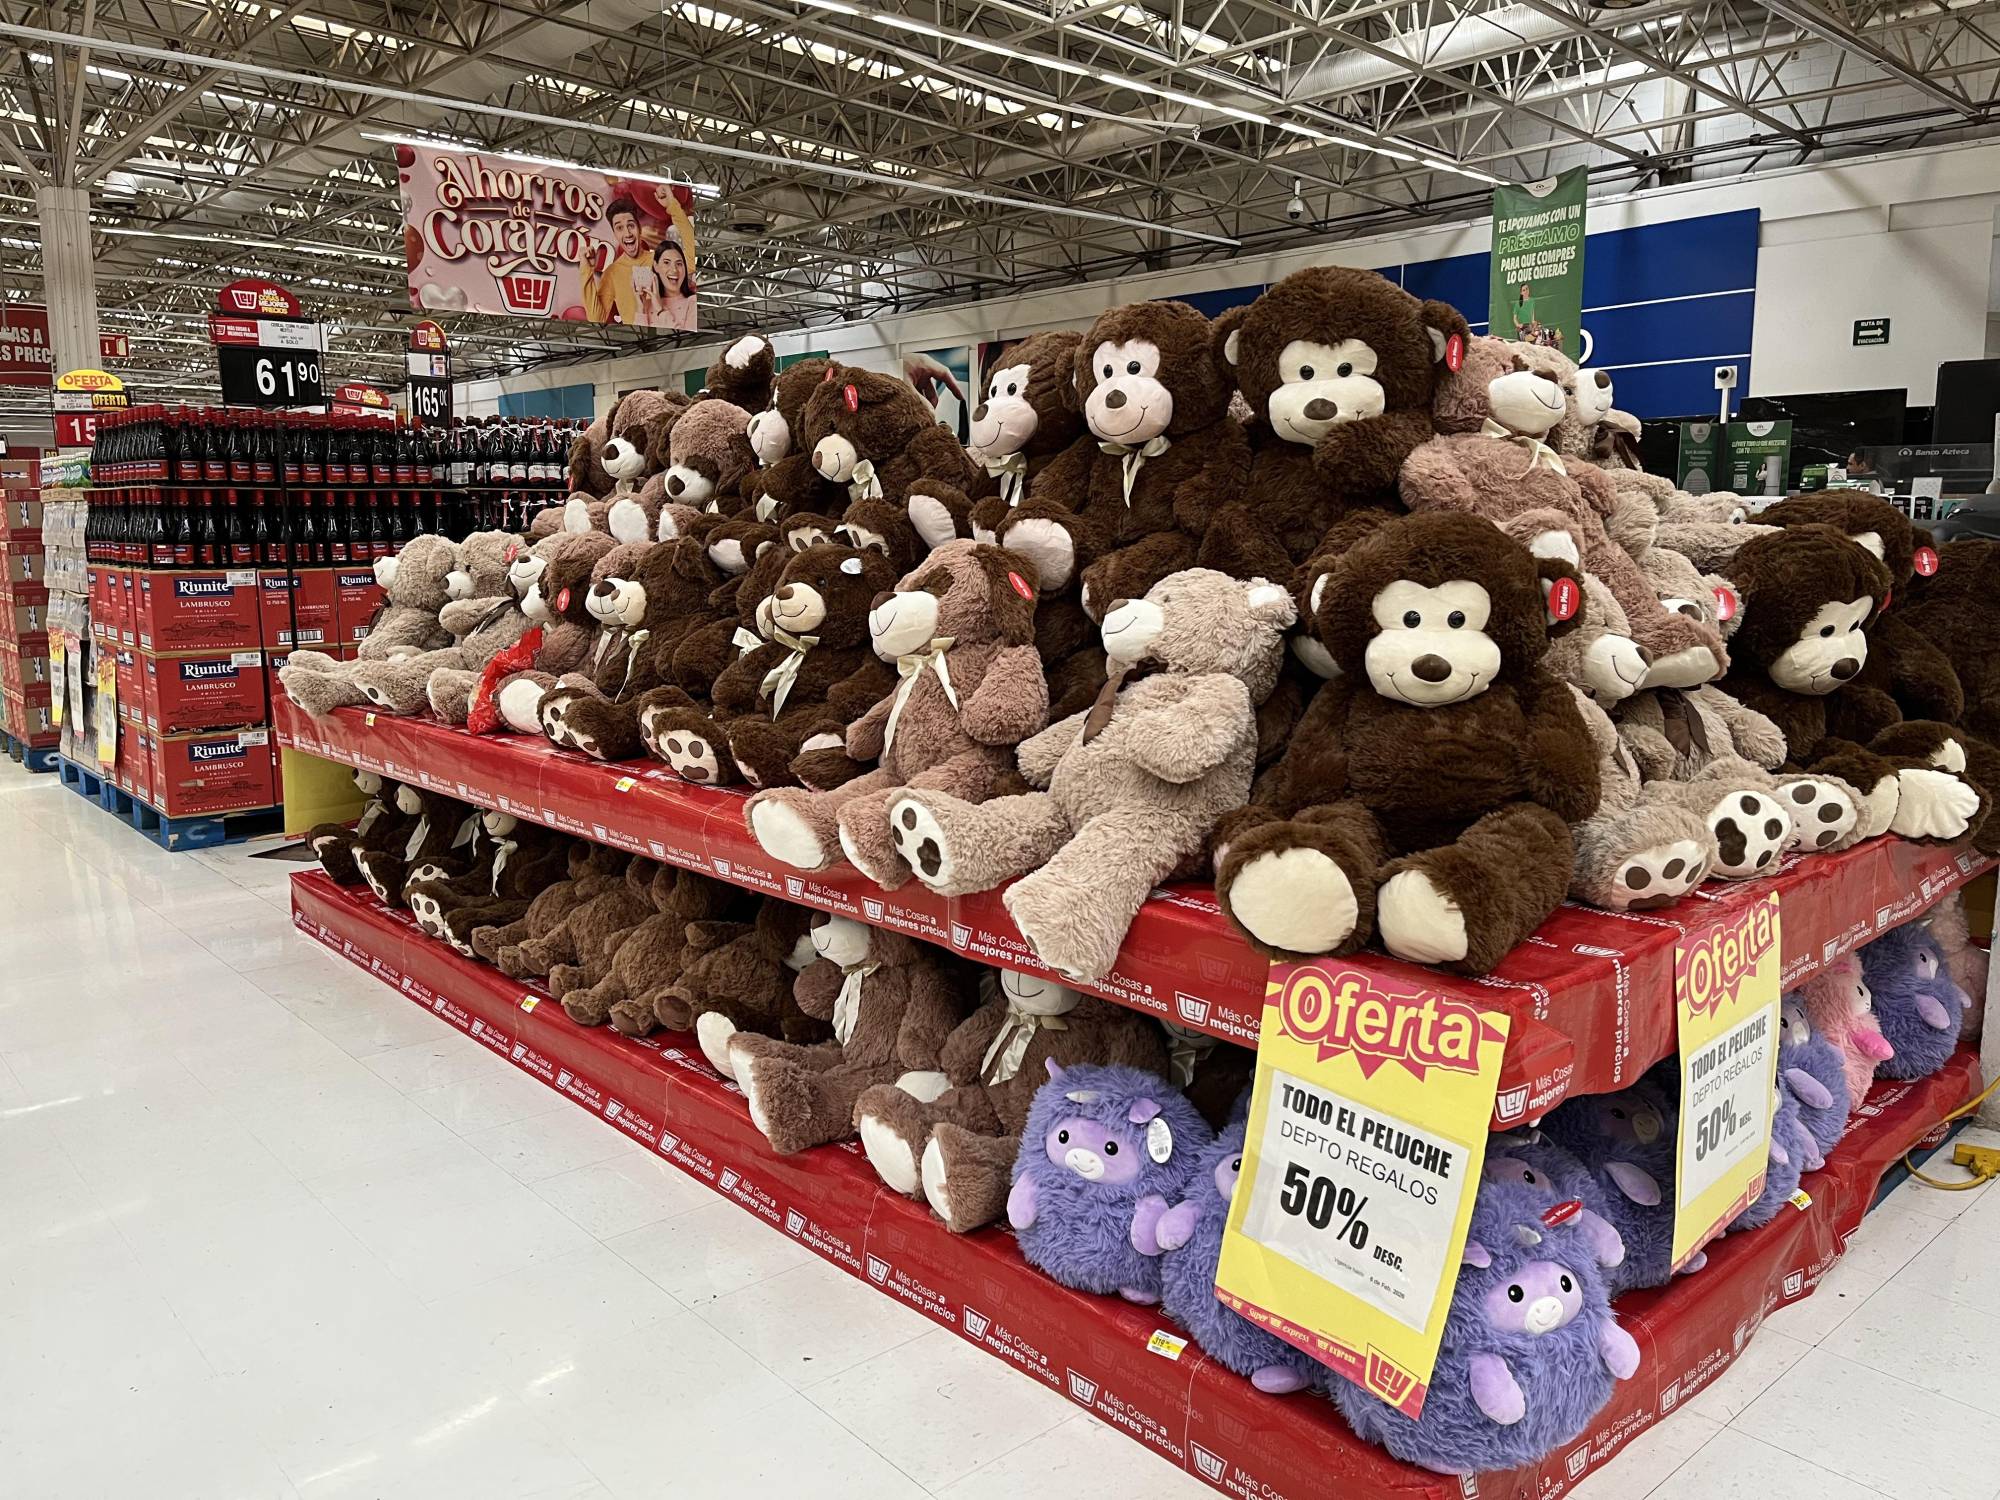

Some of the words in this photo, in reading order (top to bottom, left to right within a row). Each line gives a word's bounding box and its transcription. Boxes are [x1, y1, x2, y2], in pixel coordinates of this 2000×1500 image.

[434, 154, 606, 222] Ahorros
[511, 200, 531, 218] de
[1498, 220, 1507, 233] TE
[1506, 211, 1550, 232] APOYAMOS
[1550, 206, 1567, 222] CON
[1568, 204, 1581, 219] UN
[423, 207, 615, 278] Corazón
[1498, 223, 1580, 254] PRÉSTAMO
[1500, 256, 1520, 272] PARA
[1520, 253, 1536, 268] QUE
[1536, 246, 1576, 264] COMPRES
[1506, 270, 1516, 284] LO
[1517, 267, 1532, 282] QUE
[1533, 261, 1568, 279] QUIERAS
[33, 328, 43, 344] A
[63, 374, 113, 386] OFERTA
[256, 358, 296, 398] 61
[298, 362, 319, 384] 90
[92, 394, 128, 406] OFERTA
[414, 386, 440, 418] 165
[179, 580, 229, 595] Riunite
[341, 576, 372, 585] Riunite
[1560, 586, 1568, 603] Place
[185, 663, 234, 678] Riunite
[186, 682, 236, 691] LAMBRUSCO
[194, 744, 243, 758] Riunite
[194, 762, 244, 772] LAMBRUSCO
[804, 892, 832, 905] mejores
[834, 900, 858, 913] precios
[808, 882, 821, 893] Más
[822, 885, 841, 899] Cosas
[885, 915, 919, 931] mejores
[920, 925, 948, 939] precios
[889, 905, 904, 917] Más
[905, 909, 929, 923] Cosas
[970, 942, 1012, 960] mejores
[1015, 954, 1050, 971] precios
[978, 930, 996, 944] Más
[999, 936, 1028, 953] Cosas
[1690, 905, 1770, 1004] Oferta
[1612, 958, 1622, 1028] mejores
[1289, 975, 1473, 1061] Oferta
[1614, 1031, 1622, 1083] precios
[1623, 1048, 1630, 1057] a
[1691, 1051, 1717, 1083] TODO
[1718, 1042, 1727, 1069] EL
[1728, 1015, 1767, 1062] PELUCHE
[1536, 1075, 1552, 1092] Más
[1692, 1075, 1722, 1108] DEPTO
[1724, 1047, 1763, 1086] REGALOS
[1529, 1082, 1565, 1109] mejores
[1282, 1084, 1333, 1126] TODO
[1336, 1107, 1356, 1138] EL
[1360, 1117, 1452, 1179] PELUCHE
[1696, 1094, 1736, 1162] 50%
[1740, 1111, 1752, 1129] DESC.
[1280, 1121, 1341, 1160] DEPTO
[1346, 1150, 1438, 1205] REGALOS
[1280, 1161, 1370, 1250] 50%
[1373, 1245, 1403, 1273] DESC.
[802, 1232, 833, 1254] mejores
[834, 1248, 860, 1270] precios
[809, 1222, 821, 1236] Más
[823, 1229, 844, 1246] Cosas
[845, 1244, 850, 1253] a
[888, 1279, 923, 1304] mejores
[925, 1299, 955, 1322] precios
[896, 1269, 910, 1286] Más
[912, 1280, 936, 1300] Cosas
[939, 1295, 945, 1304] a
[995, 1324, 1011, 1341] Más
[1014, 1336, 1038, 1359] Cosas
[1040, 1356, 1047, 1366] a
[1248, 1308, 1268, 1322] Super
[1282, 1326, 1309, 1343] express
[1329, 1347, 1356, 1365] express
[986, 1334, 1026, 1364] mejores
[1028, 1357, 1060, 1385] precios
[1104, 1390, 1124, 1411] Más
[1127, 1404, 1156, 1430] Cosas
[1159, 1426, 1166, 1436] a
[1596, 1429, 1609, 1446] Más
[1611, 1412, 1634, 1433] Cosas
[1636, 1408, 1642, 1417] a
[1097, 1400, 1142, 1433] mejores
[1145, 1426, 1183, 1459] precios
[1590, 1431, 1622, 1463] mejores
[1623, 1413, 1652, 1437] precios
